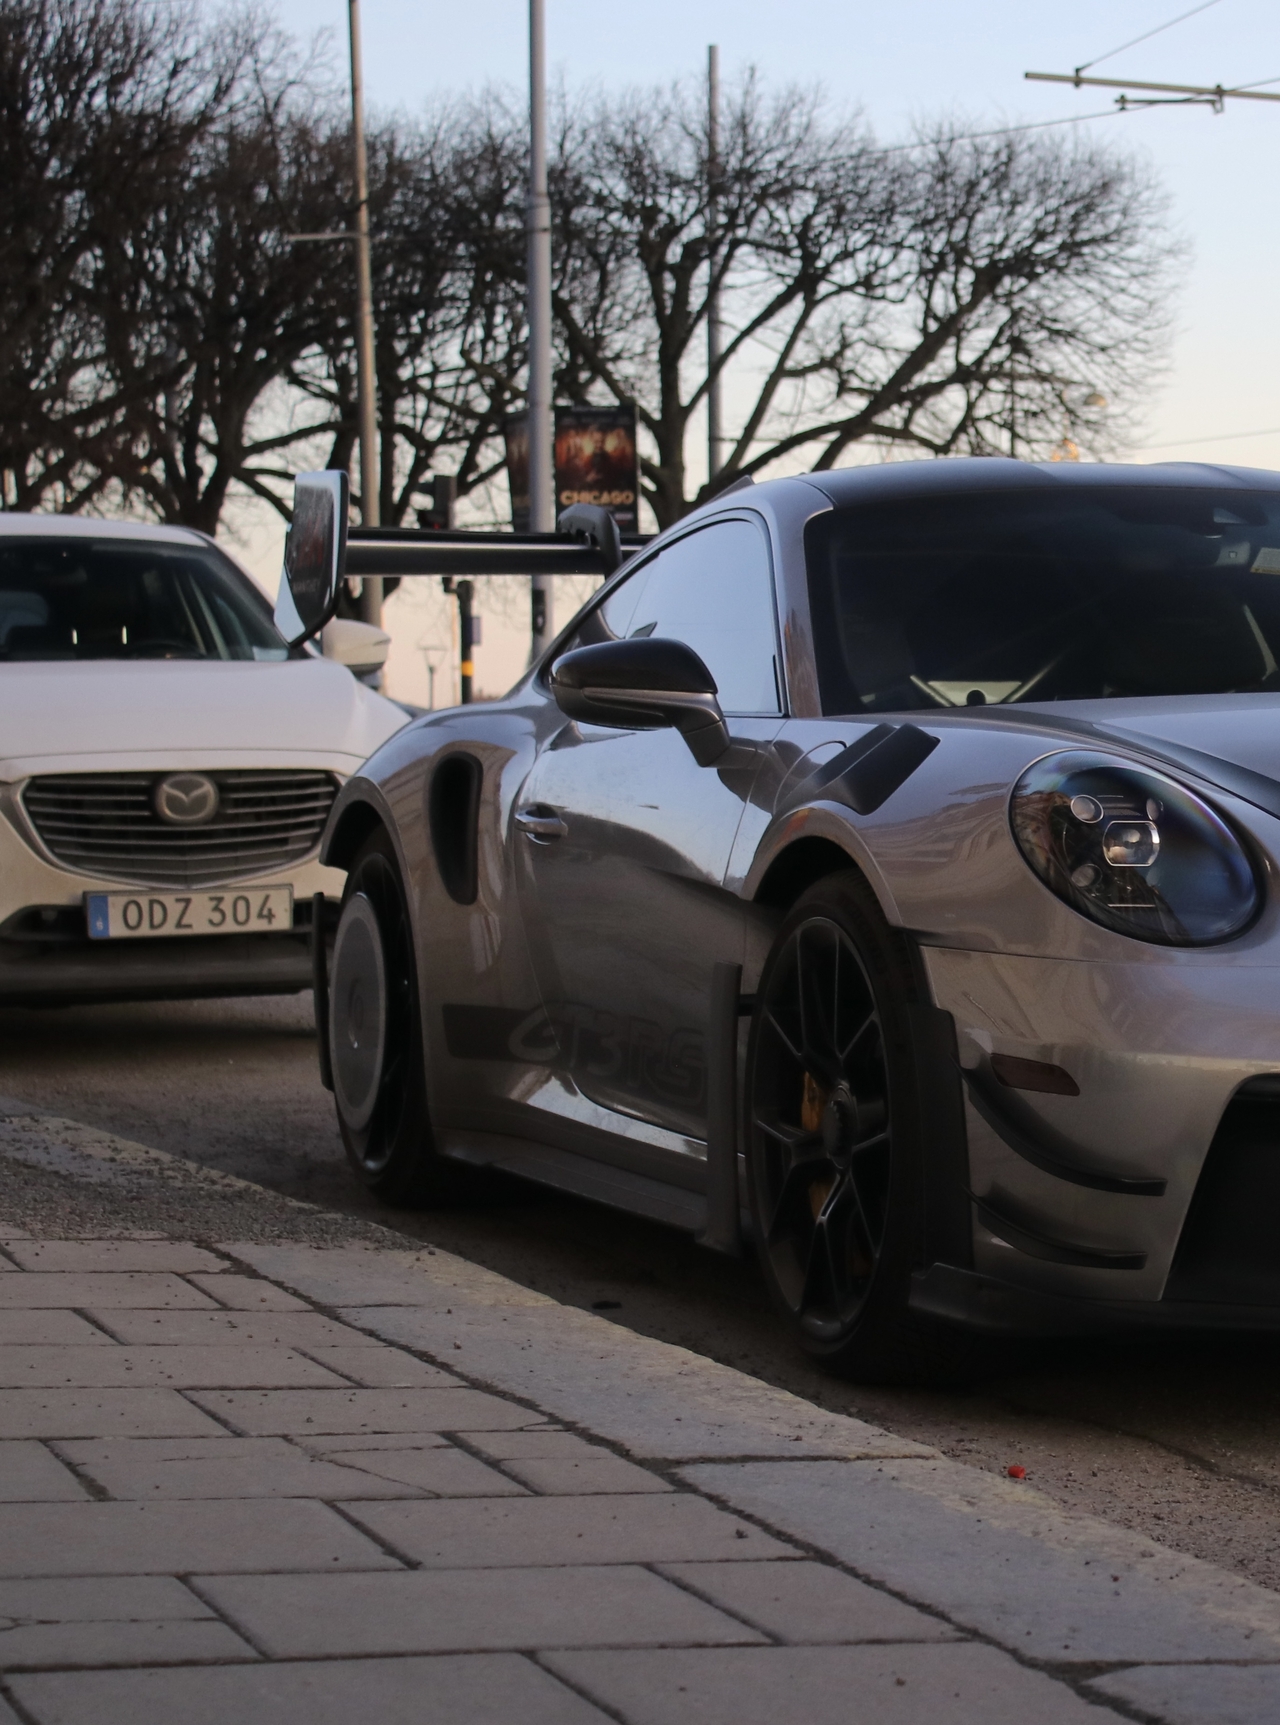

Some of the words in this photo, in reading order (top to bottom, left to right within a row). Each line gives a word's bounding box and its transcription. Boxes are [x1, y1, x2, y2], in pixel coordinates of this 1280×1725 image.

[560, 490, 634, 505] CHICAGO
[122, 897, 193, 931] ODZ
[208, 894, 276, 927] 304
